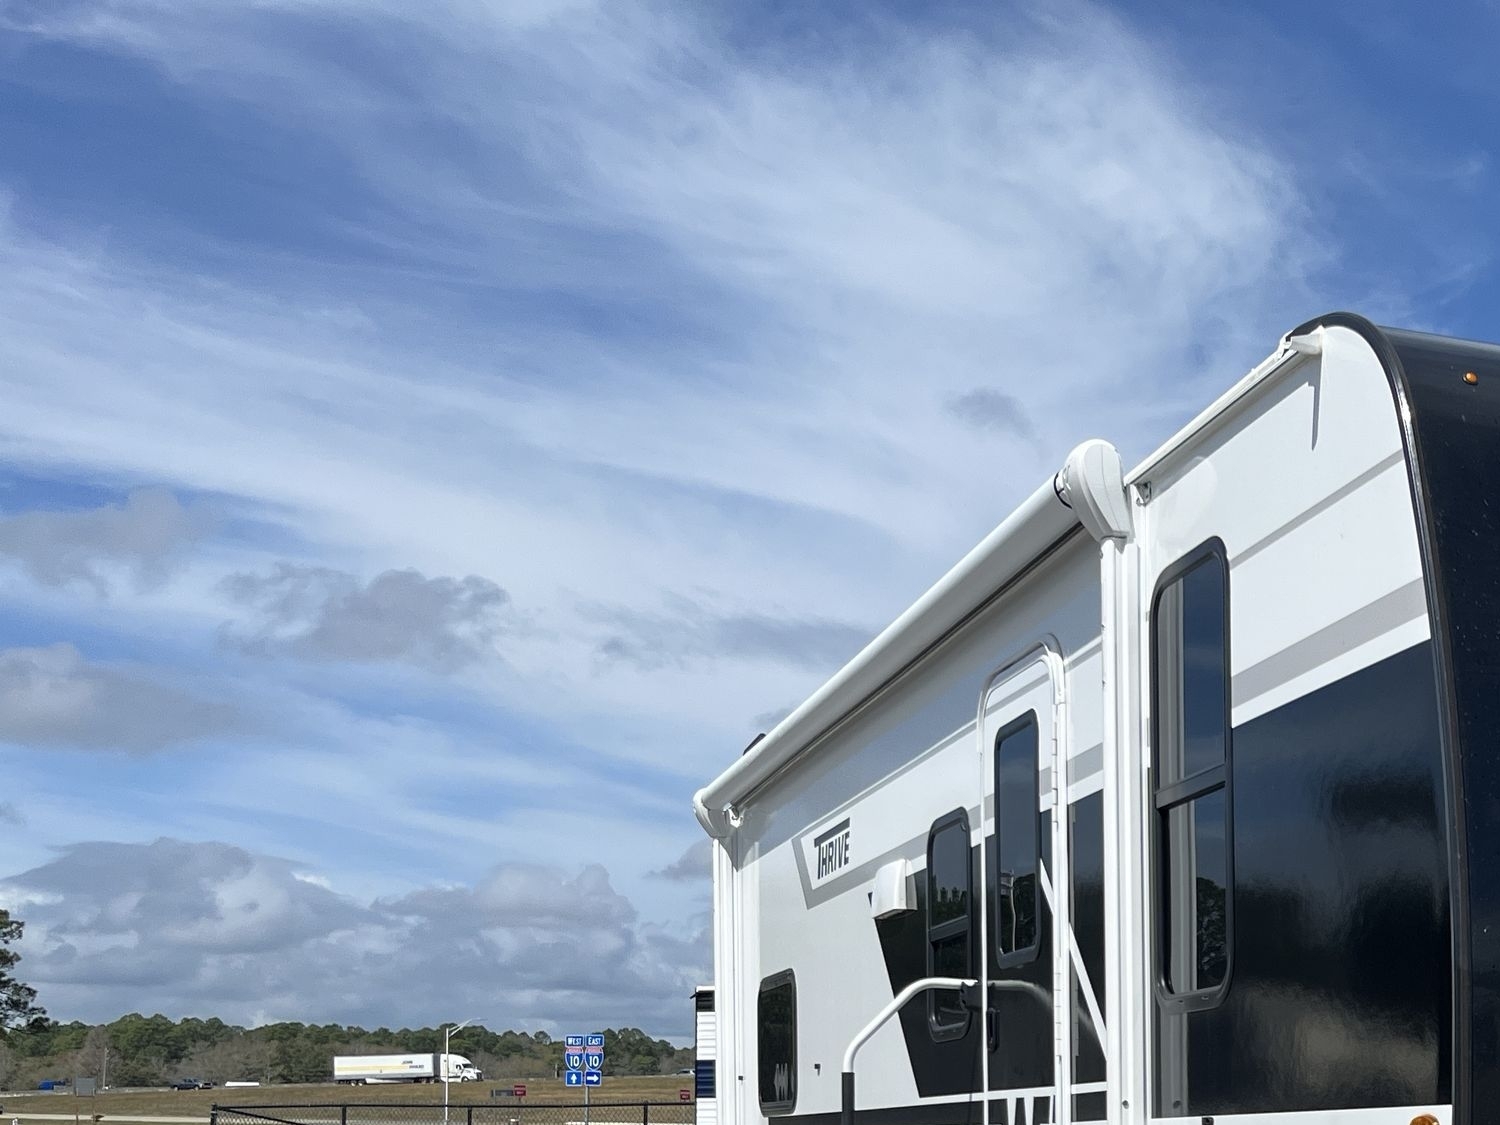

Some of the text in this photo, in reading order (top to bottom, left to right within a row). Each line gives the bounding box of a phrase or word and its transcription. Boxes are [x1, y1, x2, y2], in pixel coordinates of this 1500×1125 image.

[813, 816, 850, 879] THRIVE
[567, 1037, 582, 1045] WEST
[587, 1036, 602, 1045] EAST
[570, 1055, 580, 1067] 10
[589, 1055, 599, 1067] 10
